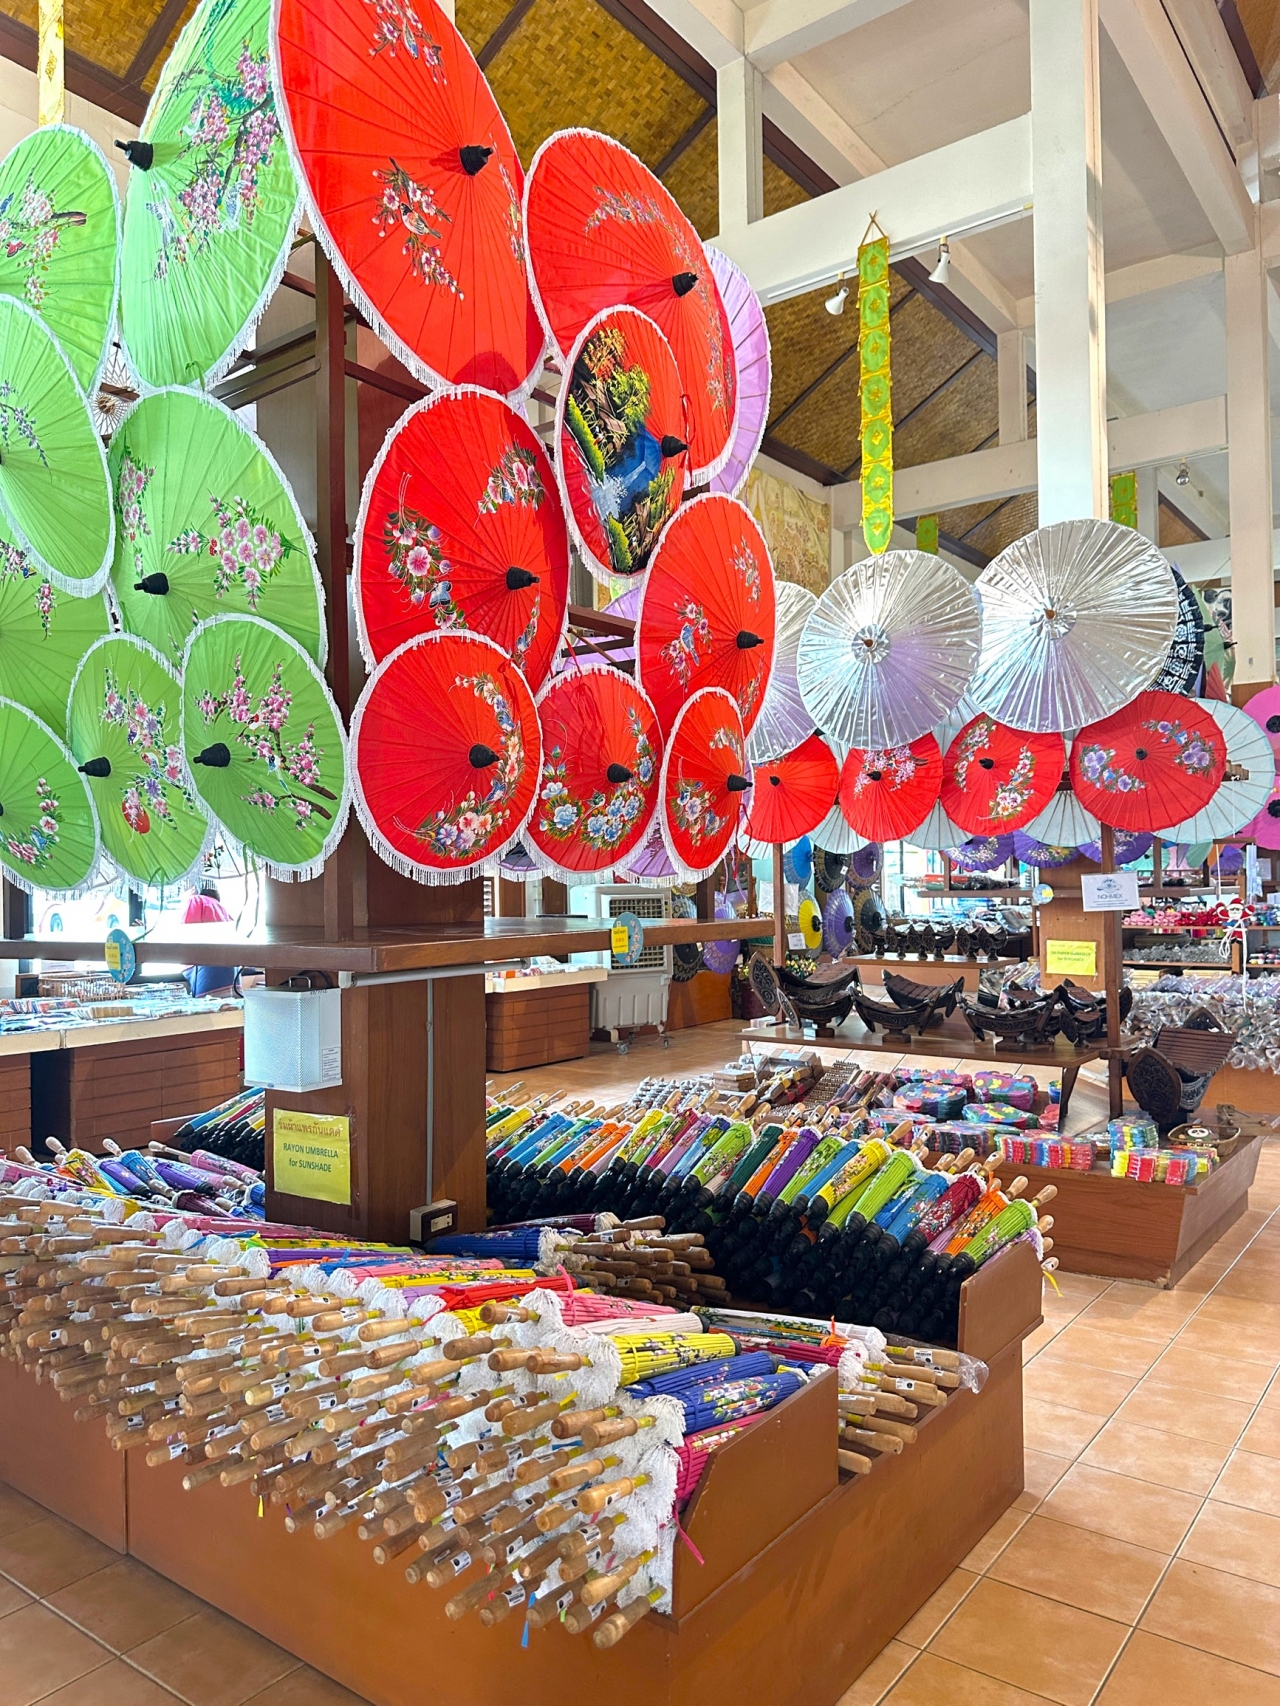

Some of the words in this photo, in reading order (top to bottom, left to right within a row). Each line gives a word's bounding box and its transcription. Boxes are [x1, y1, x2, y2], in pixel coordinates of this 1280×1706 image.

[283, 1143, 304, 1153] RAYON
[305, 1146, 339, 1158] UMBRELLA
[289, 1158, 298, 1167] for
[298, 1160, 332, 1172] SUNSHADE
